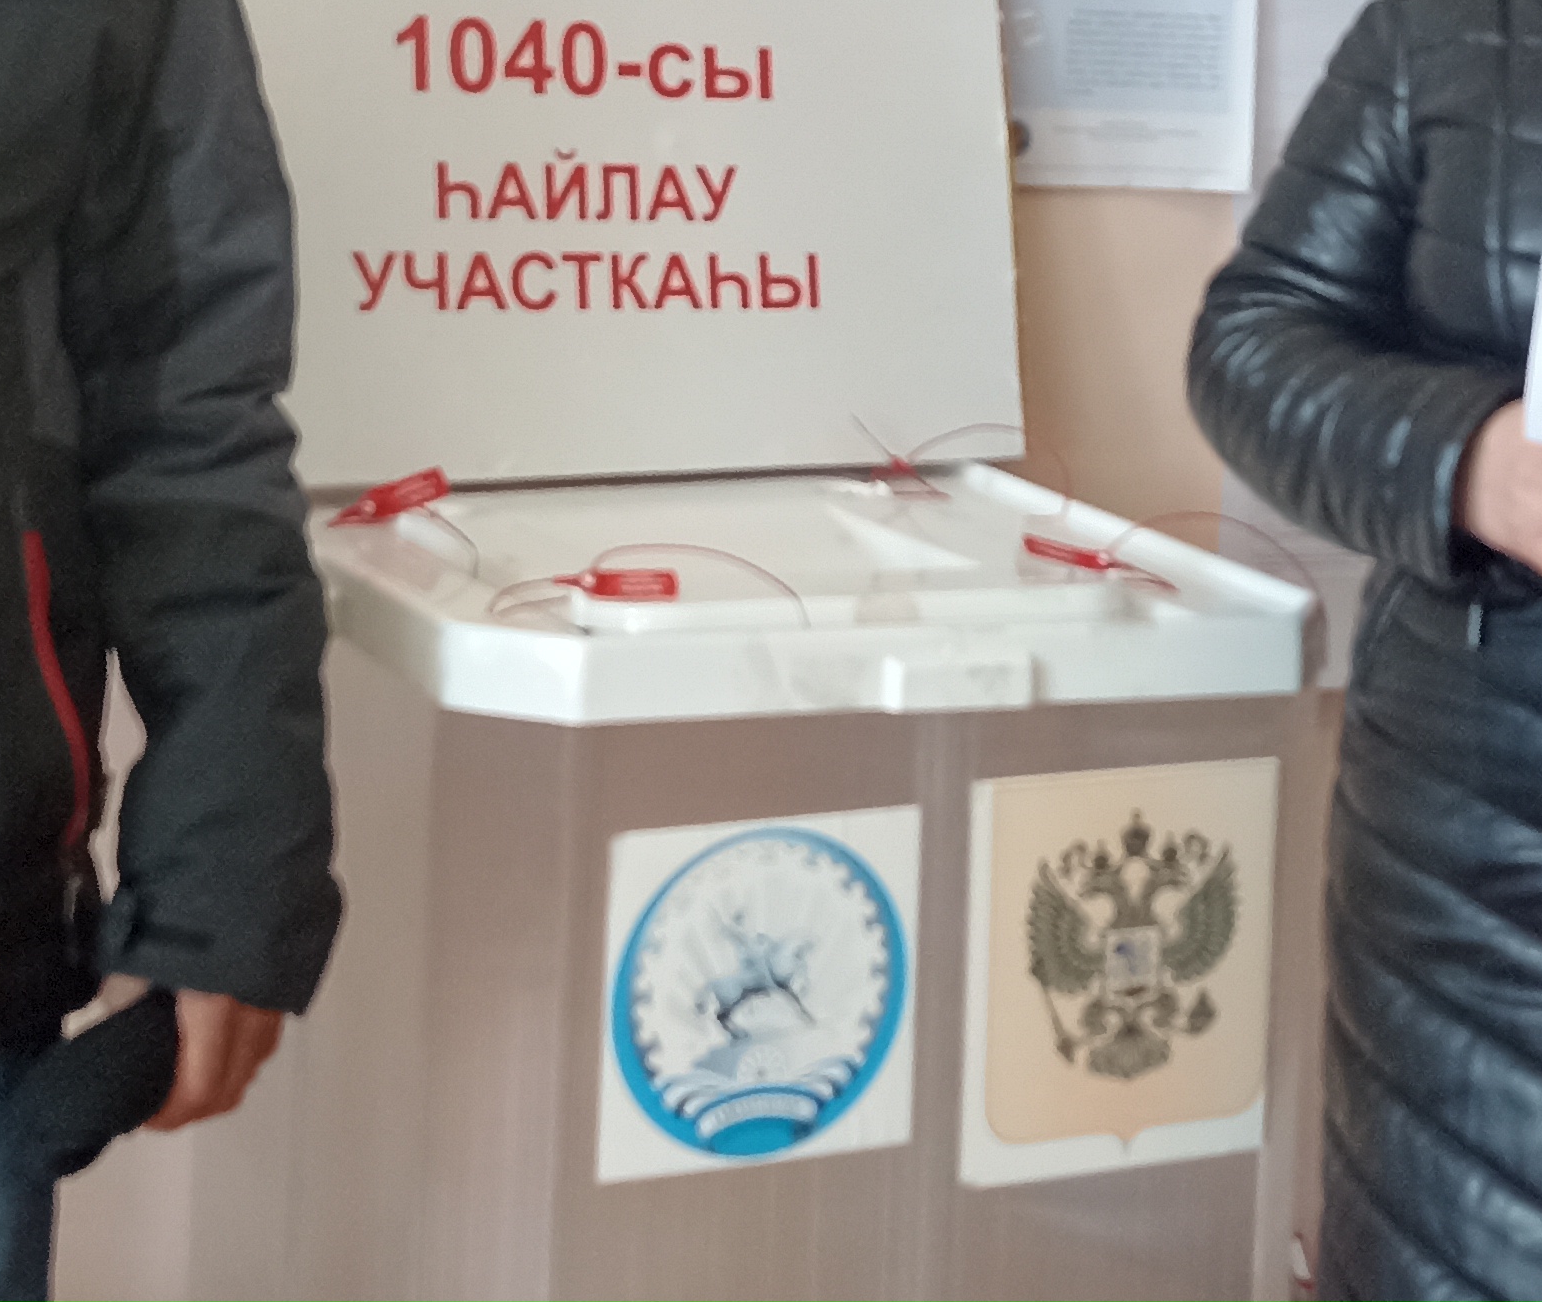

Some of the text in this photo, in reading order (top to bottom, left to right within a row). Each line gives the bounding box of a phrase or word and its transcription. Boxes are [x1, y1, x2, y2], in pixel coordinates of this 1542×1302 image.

[396, 15, 774, 99] 1040-сы
[437, 149, 738, 221] ҺАЙЛАУ
[352, 251, 821, 310] УЧАСТКАҺЫ
